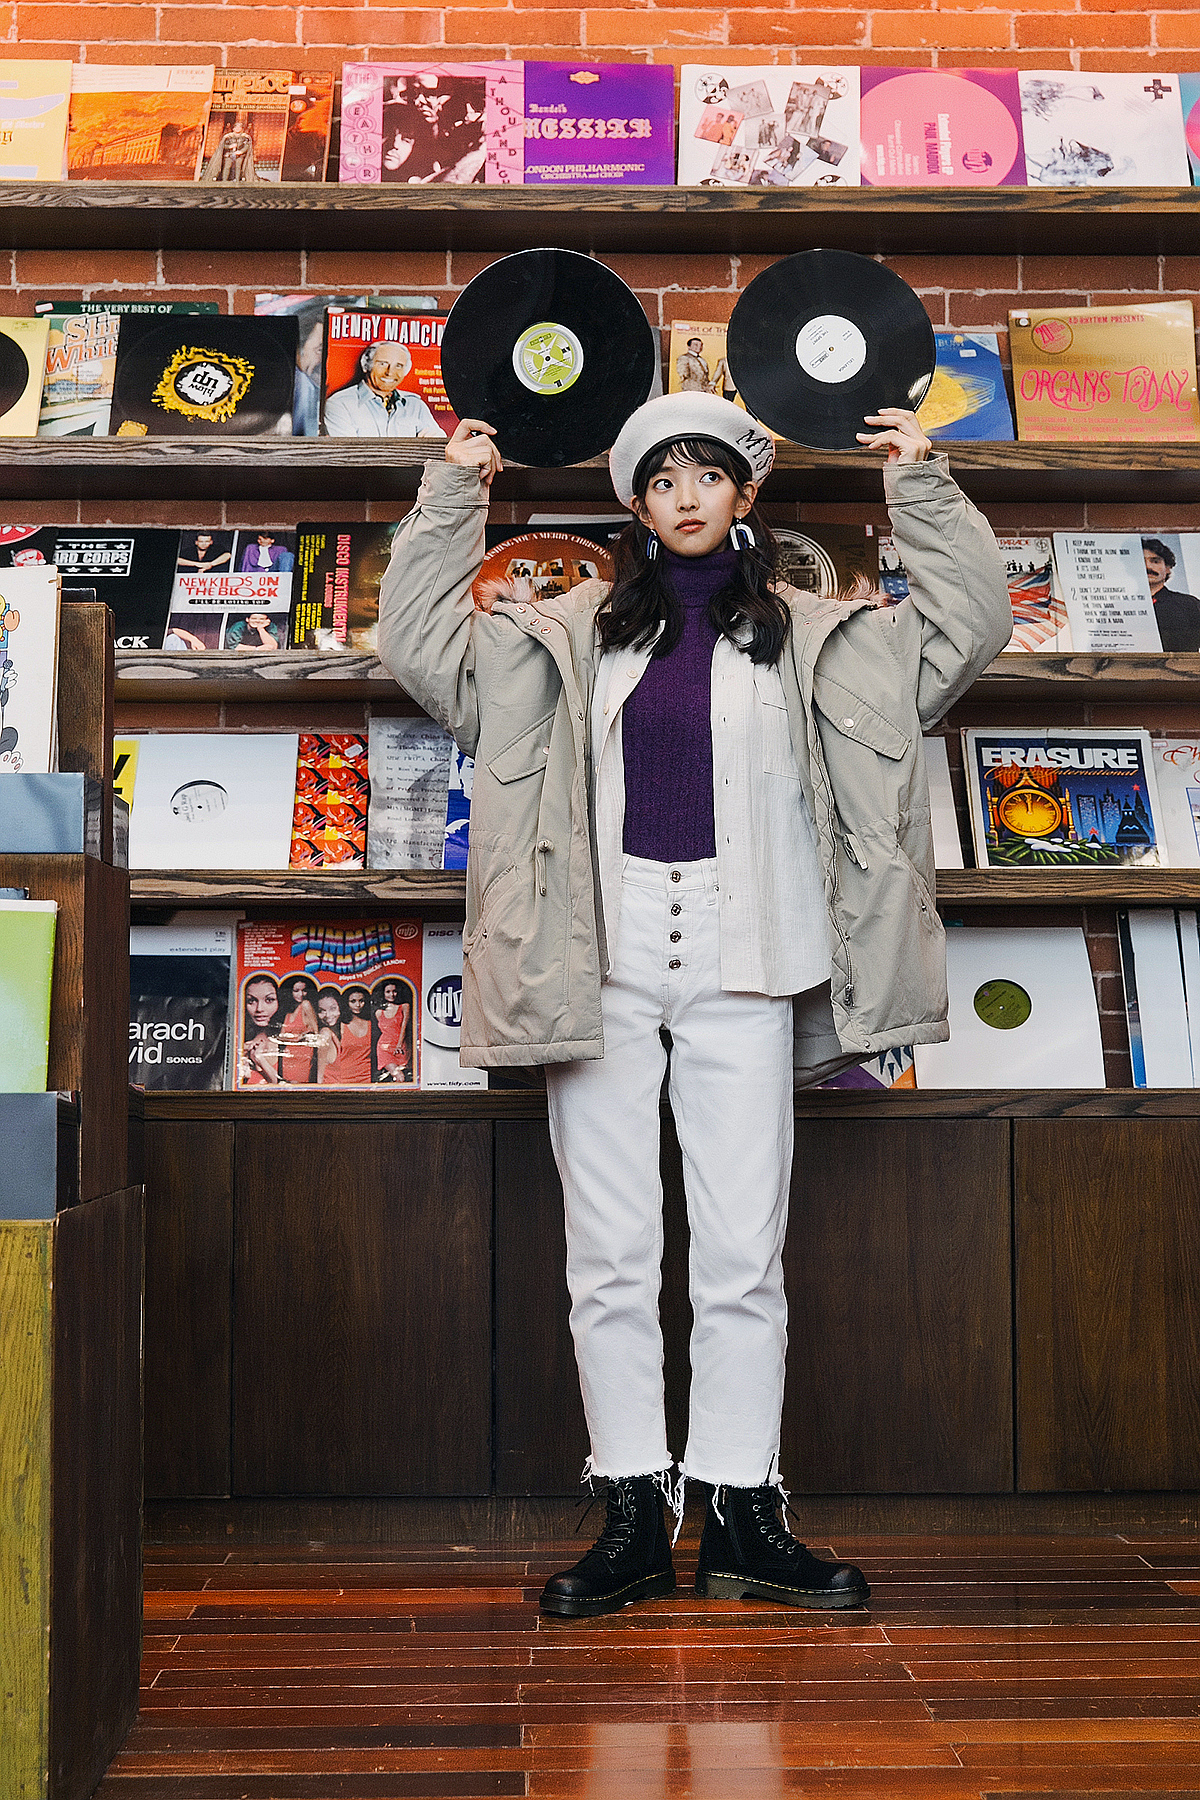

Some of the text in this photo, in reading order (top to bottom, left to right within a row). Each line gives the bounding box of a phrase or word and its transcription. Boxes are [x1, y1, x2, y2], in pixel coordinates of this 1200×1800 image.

[488, 153, 509, 184] NIGH
[565, 164, 645, 173] PHILHARMONIC
[81, 303, 173, 314] THE VERY BEST OF
[331, 315, 446, 347] HENRY MANCIN
[46, 338, 117, 374] Whit
[1020, 365, 1193, 413] ORGANS TODAY
[336, 534, 352, 565] DISCO
[513, 534, 529, 546] YOU
[539, 532, 569, 541] MERRY
[52, 551, 129, 564] ARD CORPS
[179, 576, 280, 588] NEW KIDS ON
[186, 587, 279, 597] THE BLOCK
[1071, 587, 1077, 600] 2
[114, 635, 150, 648] CK
[981, 747, 1138, 769] ERASURE
[1163, 745, 1200, 765] Ch
[403, 839, 444, 847] Manufacture
[290, 923, 393, 957] SUMMER
[304, 942, 396, 975] SAMBAS
[429, 987, 463, 1023] tidy
[129, 1019, 205, 1041] arach
[129, 1041, 203, 1064] vid SONGS
